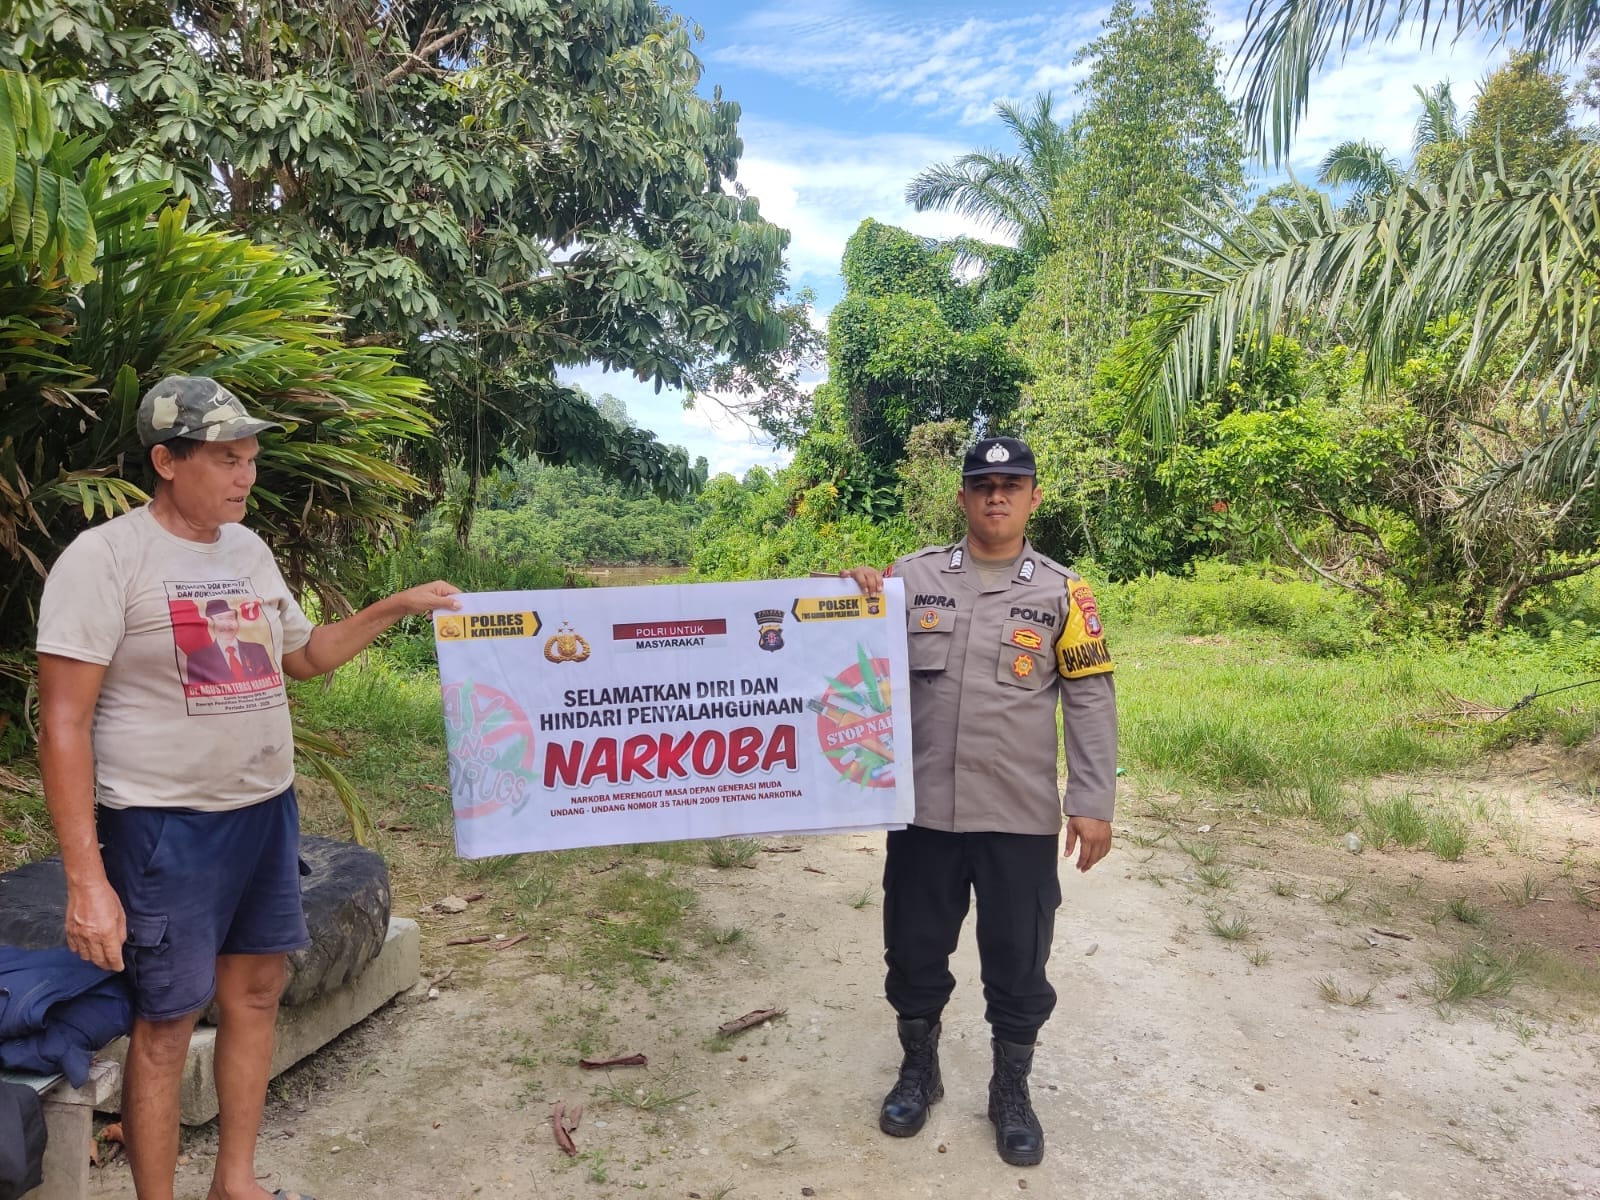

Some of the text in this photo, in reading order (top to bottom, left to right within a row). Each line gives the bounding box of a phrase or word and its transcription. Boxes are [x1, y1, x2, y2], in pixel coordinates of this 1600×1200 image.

[818, 598, 859, 611] POLSEK
[914, 594, 956, 608] INDRA
[245, 603, 256, 618] 7
[1010, 607, 1055, 627] POLRI
[470, 614, 524, 627] POLRES
[471, 626, 524, 638] KATINGAN
[636, 625, 704, 637] POLRI UNTUK
[636, 638, 705, 649] MASYARAKAT
[564, 677, 778, 708] SELAMATKAN DIRI DAN
[540, 697, 803, 731] HINDARI PENYALAHGUNAAN
[826, 725, 865, 746] STOP
[543, 724, 797, 788] NARKOBA
[571, 781, 782, 804] NARKOBA MERENGGUT MASA DEPAN GENERASI MUDA
[550, 808, 584, 817] UNDANG
[592, 804, 625, 813] UNDANG
[628, 801, 657, 810] NOMOR
[660, 800, 670, 808] 35
[672, 798, 698, 806] TAHUN
[700, 796, 720, 804] 2009
[722, 794, 756, 803] TENTANG
[758, 790, 802, 800] NARKOTIKA
